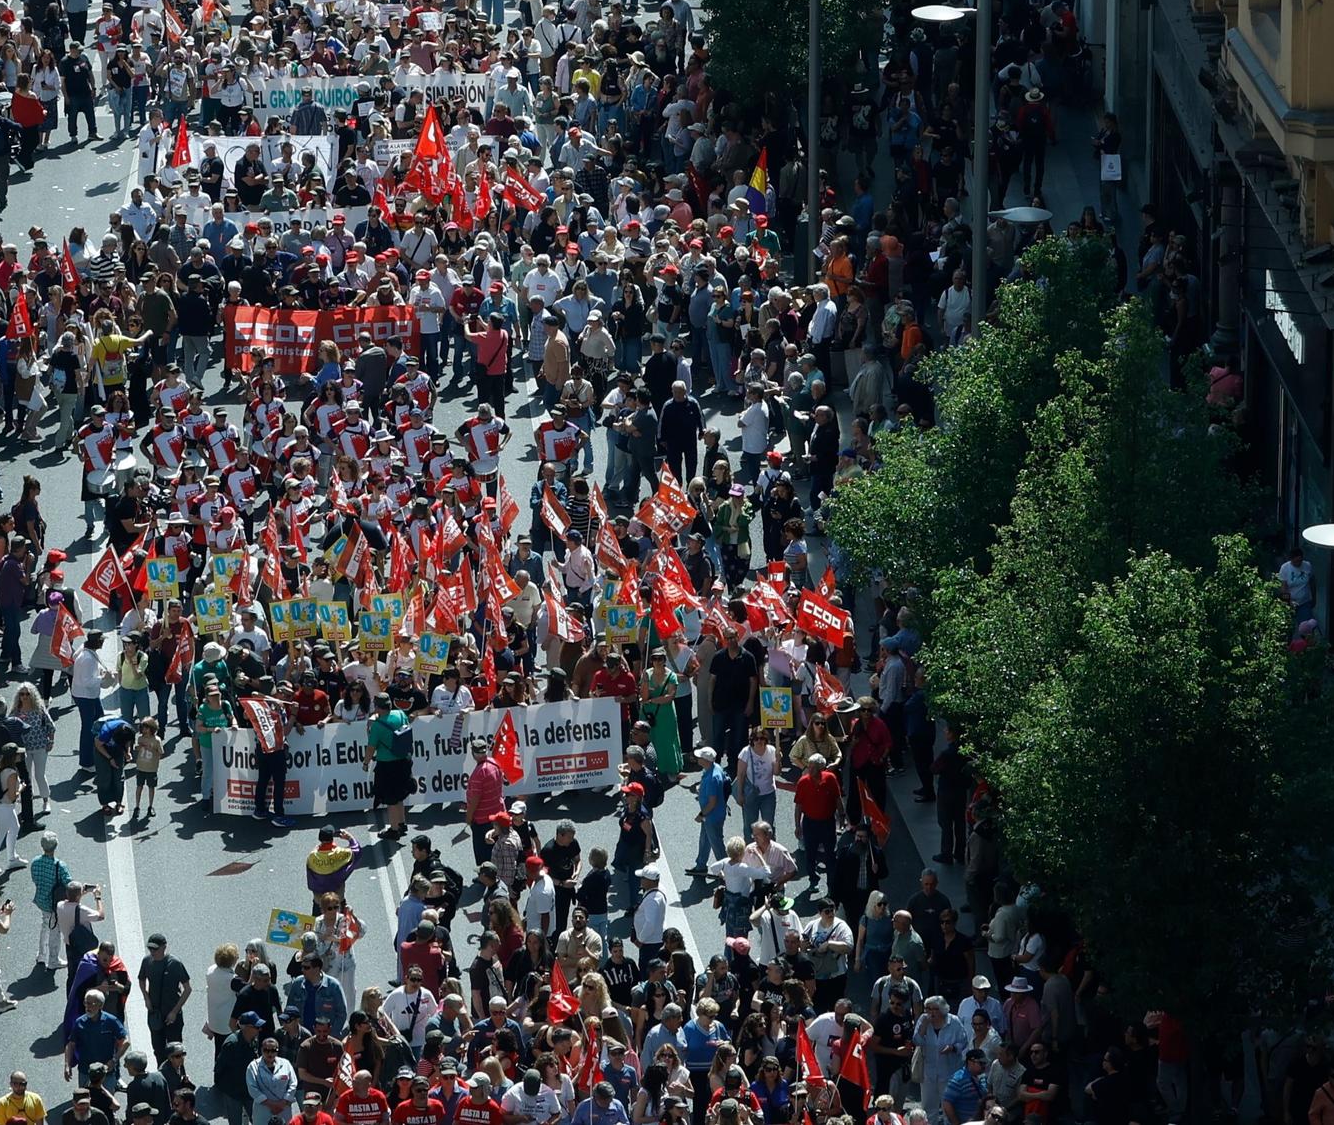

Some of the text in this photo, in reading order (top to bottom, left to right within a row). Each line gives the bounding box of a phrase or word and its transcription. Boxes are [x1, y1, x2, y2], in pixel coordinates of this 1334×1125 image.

[252, 90, 267, 109] EL
[270, 89, 303, 109] GRUP
[235, 322, 316, 343] CCOO
[234, 344, 314, 357] peionistas
[802, 598, 842, 630] CCOO
[223, 742, 260, 772] Unid
[317, 744, 332, 767] la
[523, 724, 540, 747] la
[544, 720, 611, 745] defensa
[539, 757, 588, 774] CCOO
[327, 779, 349, 803] de
